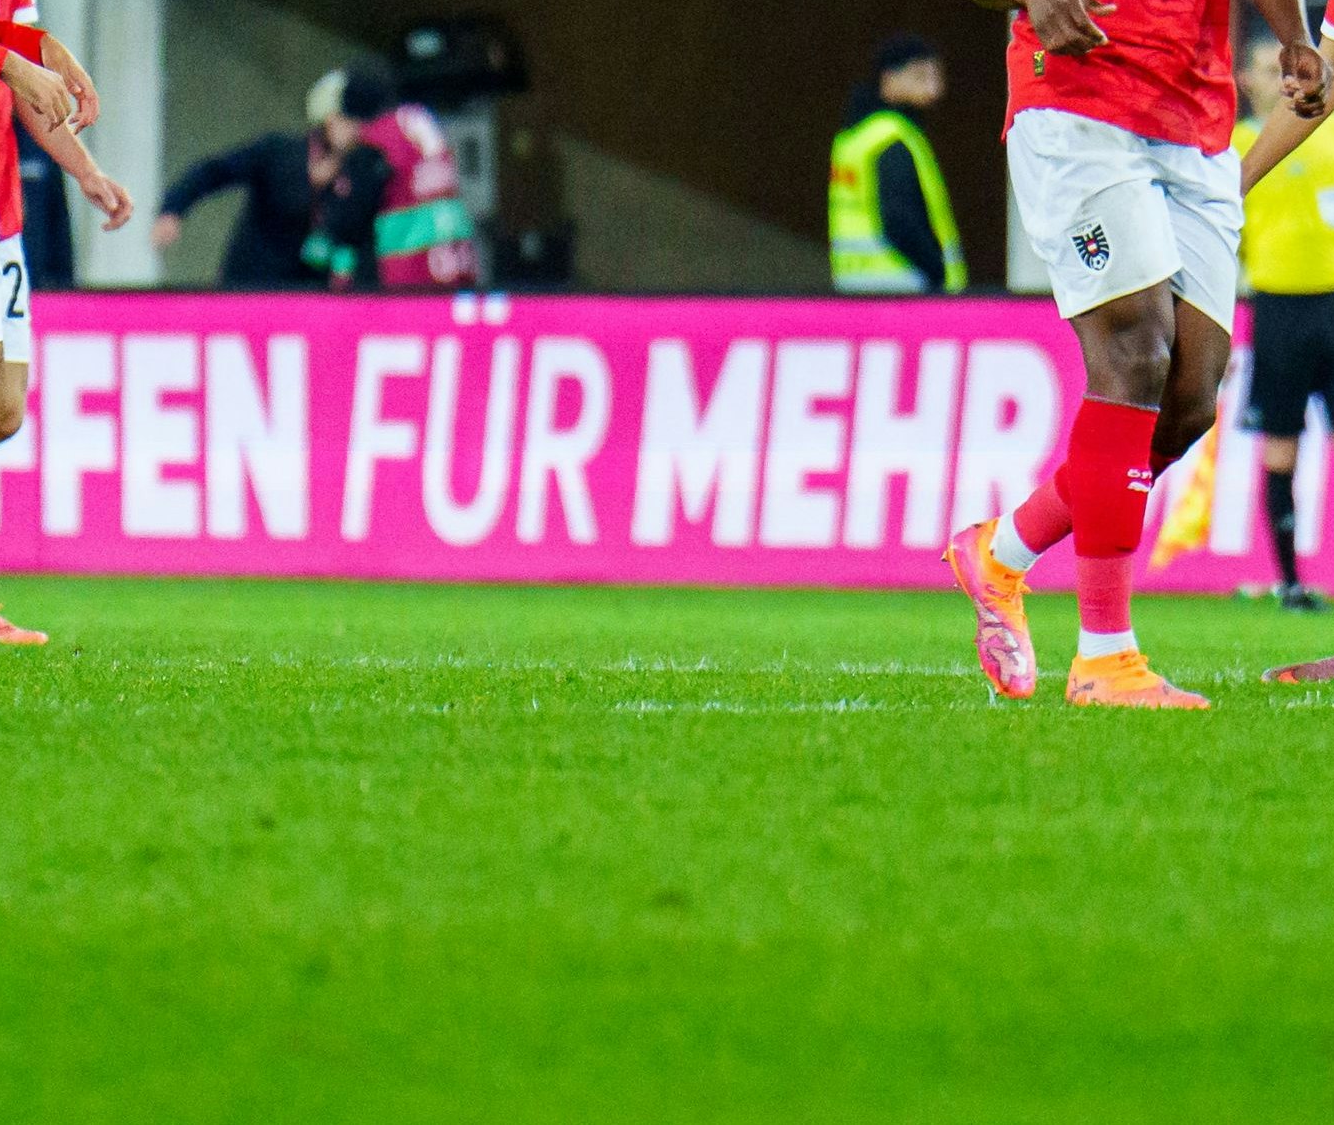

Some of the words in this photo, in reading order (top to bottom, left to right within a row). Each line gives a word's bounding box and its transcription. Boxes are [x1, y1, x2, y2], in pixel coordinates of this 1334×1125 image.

[2, 260, 25, 318] 2
[339, 291, 613, 546] FÜR
[630, 336, 1062, 551] MEHR
